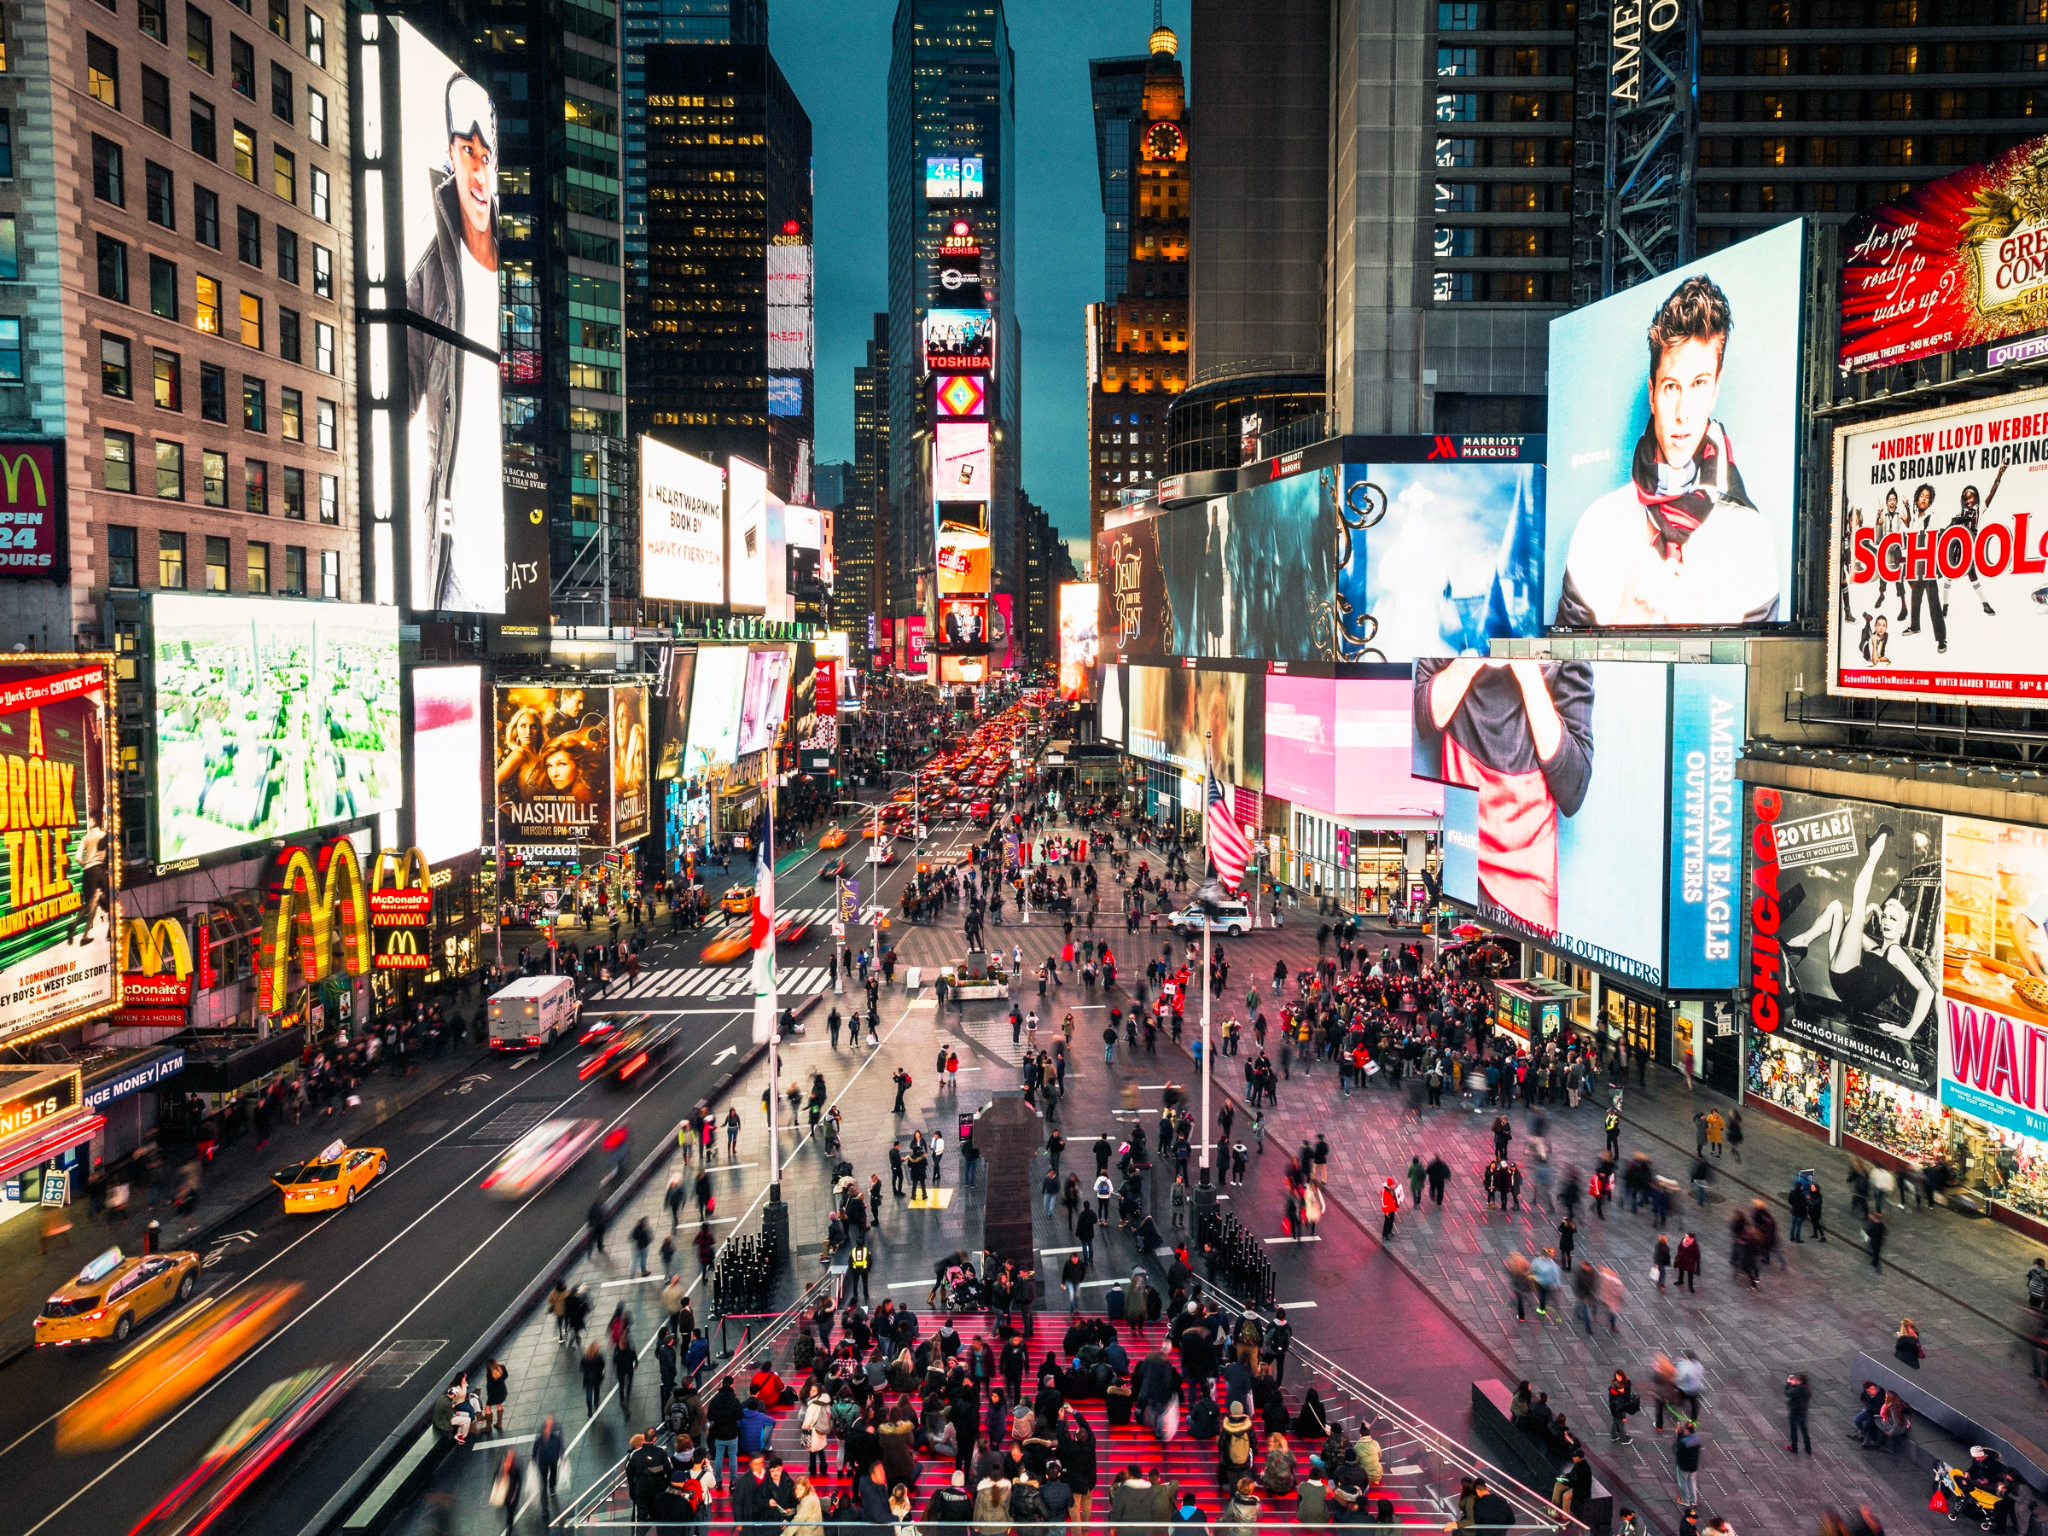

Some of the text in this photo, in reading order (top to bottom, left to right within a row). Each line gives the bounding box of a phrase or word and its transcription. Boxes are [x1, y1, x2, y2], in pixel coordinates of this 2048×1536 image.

[934, 164, 975, 179] 4:50
[940, 247, 980, 255] TOSHIBA
[946, 236, 974, 247] 2017
[1847, 222, 1919, 265] Are you
[1862, 240, 1926, 300] ready to
[1872, 271, 1955, 328] wake up?
[929, 356, 992, 367] TOSHIBA
[1853, 351, 1880, 365] IMPERIAL
[1880, 344, 1906, 360] THEATRE
[1910, 340, 1922, 350] 249
[1463, 437, 1524, 446] MARRIOTT
[1938, 424, 1983, 451] LLOYD
[1281, 451, 1303, 463] MARRIOTT
[1463, 448, 1517, 457] MARQUIS
[509, 469, 539, 480] BACK AND
[1281, 462, 1301, 474] MARQUIS
[1871, 462, 1896, 485] HAS
[1900, 449, 1976, 481] BROADWAY
[2029, 464, 2048, 473] REUTER
[512, 476, 529, 487] THAN
[1162, 478, 1183, 489] MARRIOTT
[648, 483, 720, 519] A HEARTWARMING
[1162, 488, 1180, 499] MARQUIS
[670, 511, 702, 534] BOOK BY
[0, 527, 37, 549] 24
[1850, 513, 2047, 584] SCHOOL
[684, 545, 720, 565] FIERSTEN
[1112, 540, 1142, 597] BEAUTY
[705, 617, 817, 639] 1540 BROADWAY
[1117, 593, 1142, 649] BEAST
[5, 690, 25, 706] York
[24, 686, 50, 699] Times
[84, 670, 103, 686] PICK
[1844, 674, 1929, 686] SchoolOfRockTheMusical.com
[1935, 677, 1958, 687] WINTER
[1960, 678, 1984, 688] GARDEN
[1985, 679, 2013, 690] THEATRE
[2036, 682, 2042, 690] &
[29, 706, 46, 759] A
[512, 802, 598, 824] NASHVILLE
[617, 794, 645, 822] NASHVILLE
[521, 826, 590, 836] THURSDAYS 9PM CMT
[1684, 752, 1706, 904] OUTFITTERS
[1704, 696, 1734, 960] AMERICAN EAGLE
[1777, 815, 1850, 847] 20 YEARS
[1784, 844, 1850, 862] KILLING IT WORLDWIDE
[4, 828, 72, 909] TALE
[412, 868, 452, 888] ERESS
[372, 896, 429, 904] McDonald's
[1752, 787, 1782, 1032] CHICAGO
[0, 908, 34, 938] ADWAY'S
[1477, 904, 1661, 986] AMERICAN EAGLE OUTFITTERS
[25, 960, 77, 986] COMBINATION OF
[13, 987, 35, 1003] BOYS
[36, 984, 42, 995] &
[44, 976, 65, 992] WEST
[66, 972, 83, 986] SIDE
[124, 984, 187, 995] cDonald's
[1791, 1018, 1919, 1073] CHICAGOTHEMUSICAL.COM
[113, 1068, 155, 1098] MONEY
[160, 1056, 183, 1076] ATM
[2026, 1115, 2048, 1133] WAIT
